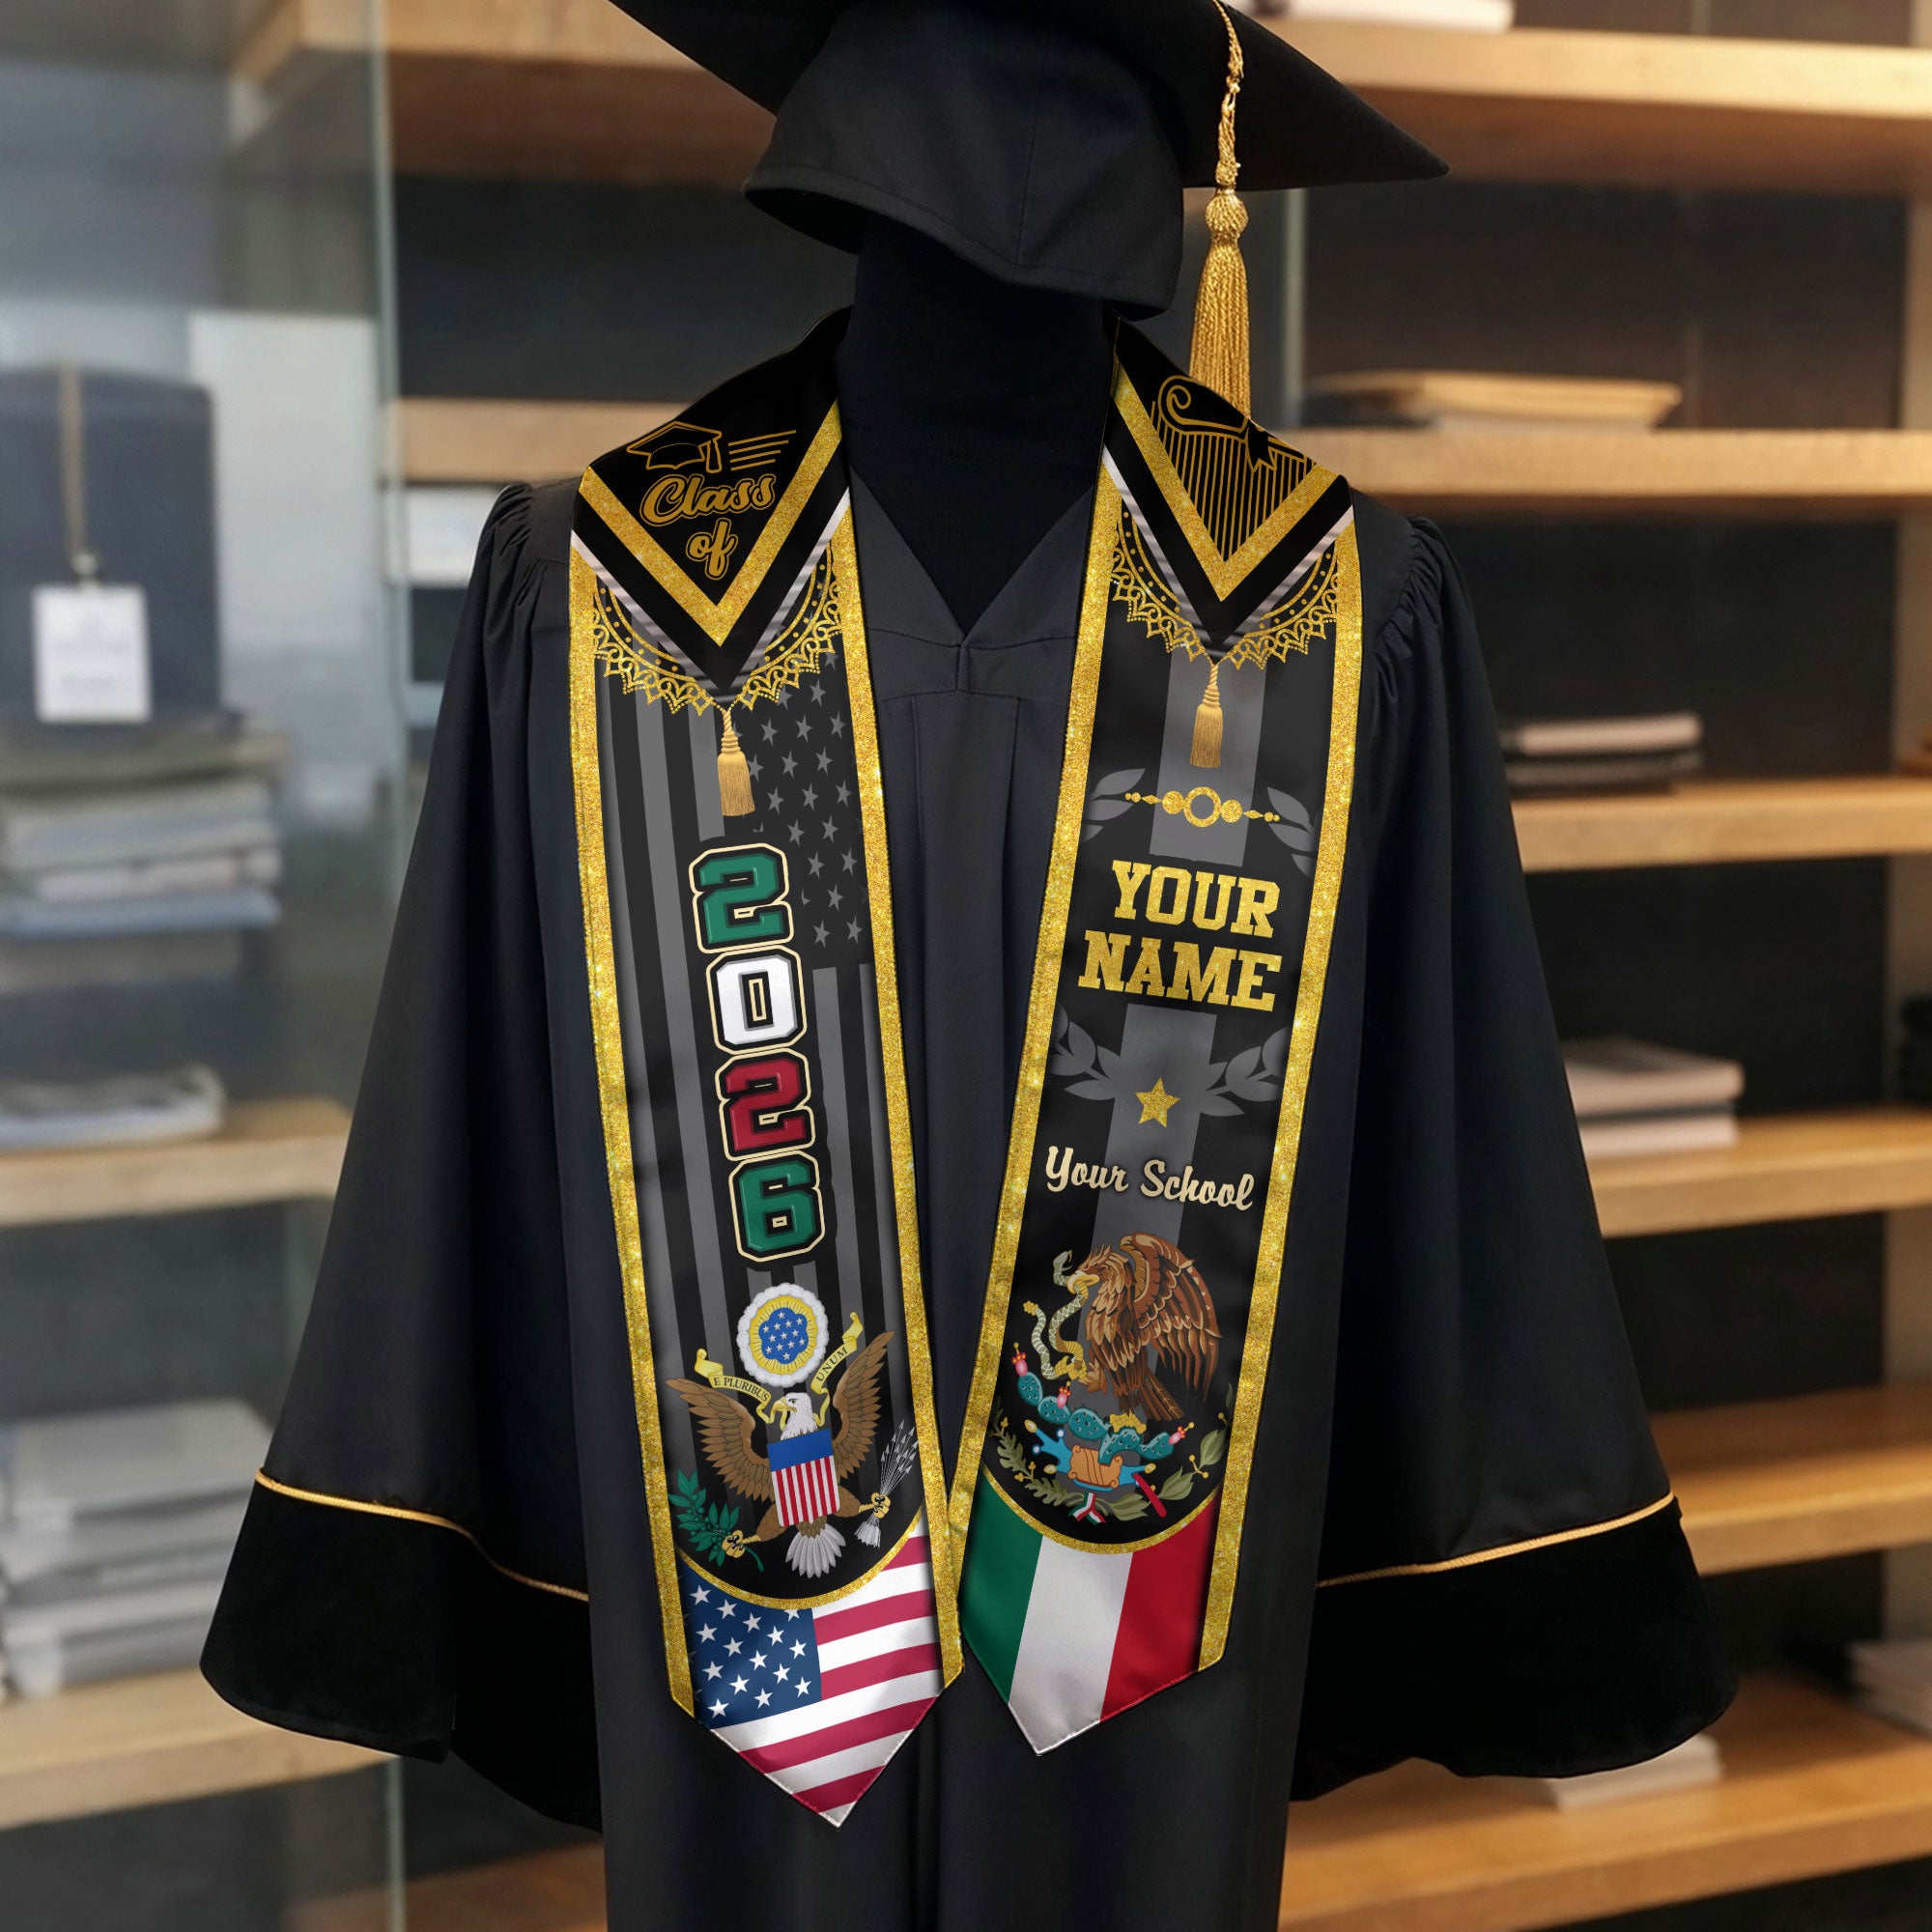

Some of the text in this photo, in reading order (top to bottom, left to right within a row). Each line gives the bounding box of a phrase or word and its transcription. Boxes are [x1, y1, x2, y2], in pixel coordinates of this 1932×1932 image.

[639, 474, 777, 526] Class
[686, 518, 738, 580] of
[1111, 860, 1280, 938] YOUR
[1078, 930, 1283, 1011] NAME
[689, 842, 825, 1262] 2026
[1045, 1146, 1255, 1210] Your School
[713, 1347, 848, 1402] E PLURIBUS UNUM
